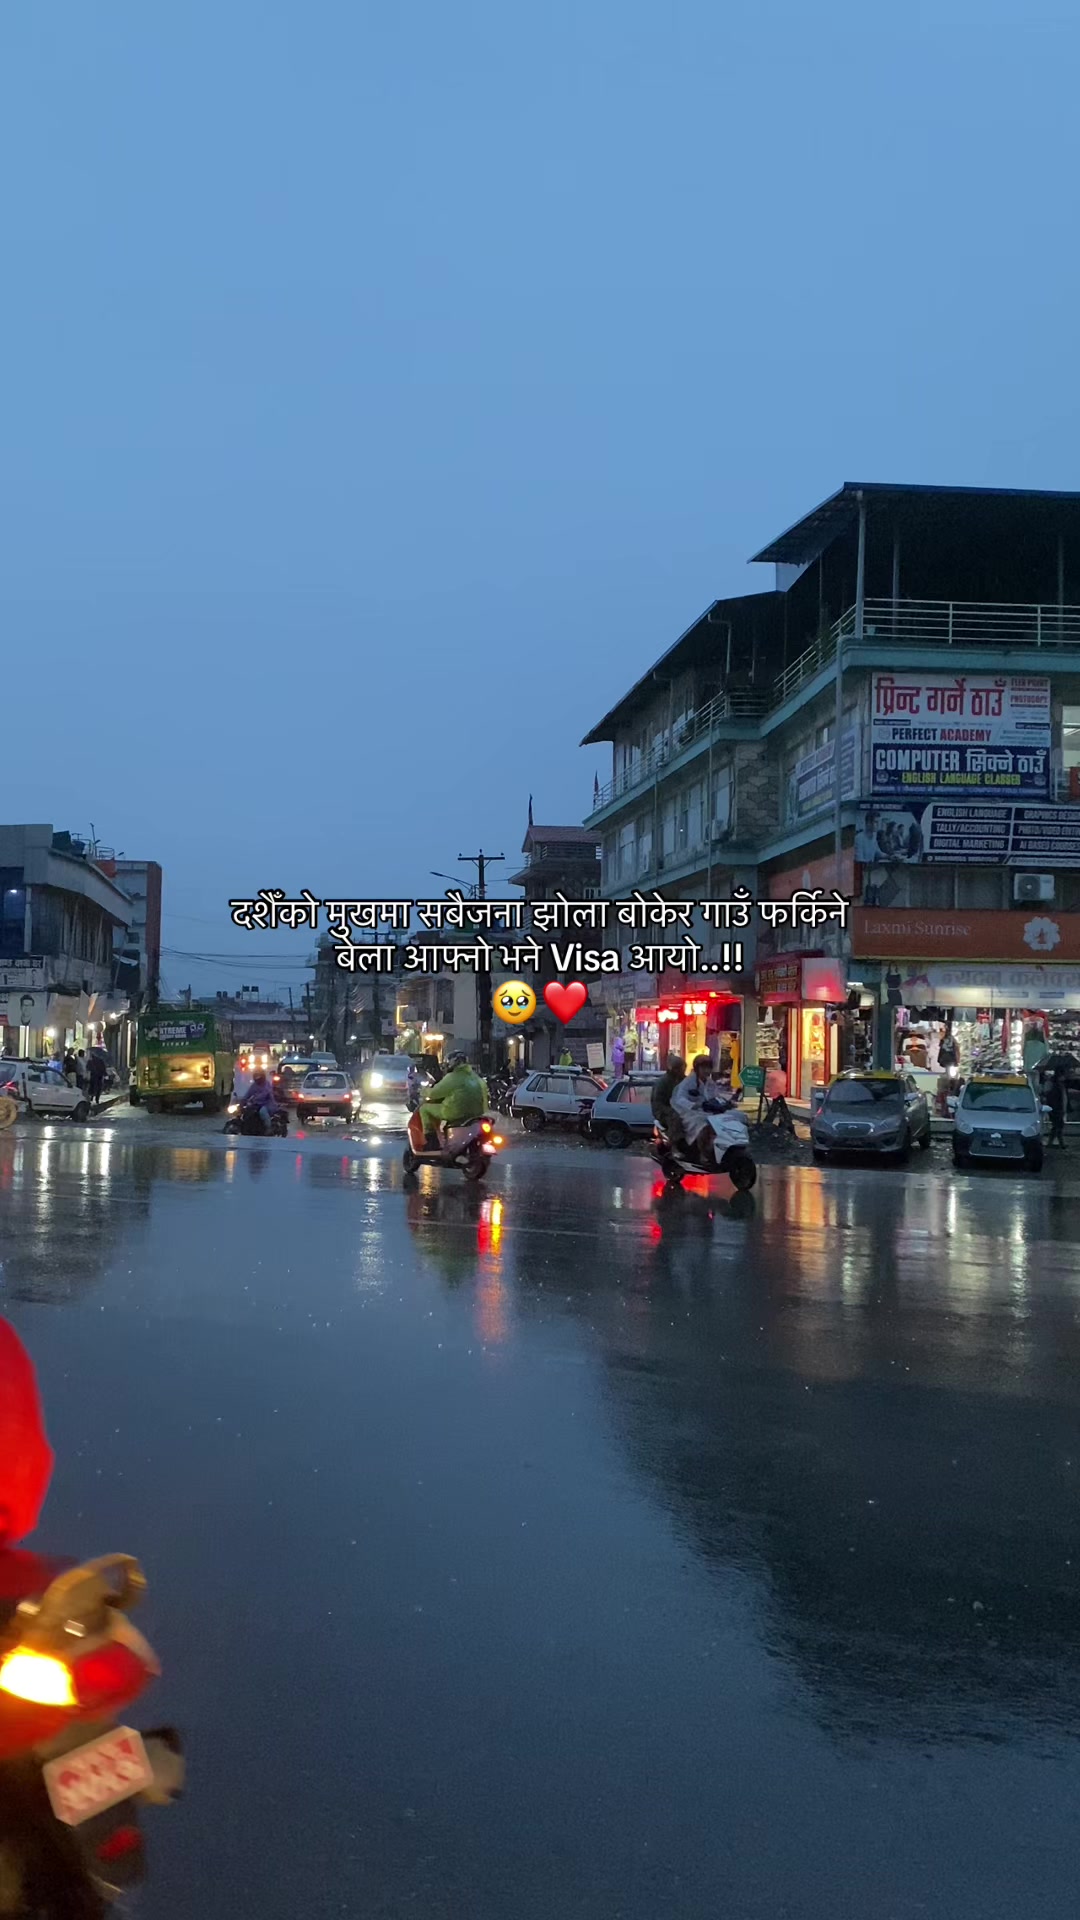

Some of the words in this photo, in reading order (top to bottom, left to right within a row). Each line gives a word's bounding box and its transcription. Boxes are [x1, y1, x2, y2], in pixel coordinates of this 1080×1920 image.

[875, 677, 921, 716] प्रिन्ट
[926, 678, 966, 716] गर्ने
[970, 678, 1007, 717] ठाउँ
[892, 727, 938, 741] PERFECT
[940, 729, 991, 742] ACADEMY
[875, 749, 960, 772] COMPUTER
[965, 749, 1014, 773] सिक्ने
[1017, 749, 1047, 774] ठाउँ
[901, 773, 937, 785] ENGLISH
[940, 773, 981, 785] LANGUAGE
[985, 774, 1021, 786] CLASSES
[937, 807, 968, 818] ENGLISH
[969, 808, 1007, 819] LANGUAGE
[936, 823, 1005, 835] TALLY/ACCOUNTING
[934, 838, 960, 849] DIGITAL
[962, 839, 1005, 850] MARKETING
[863, 920, 911, 936] Laxmi
[915, 922, 970, 937] Sunrise
